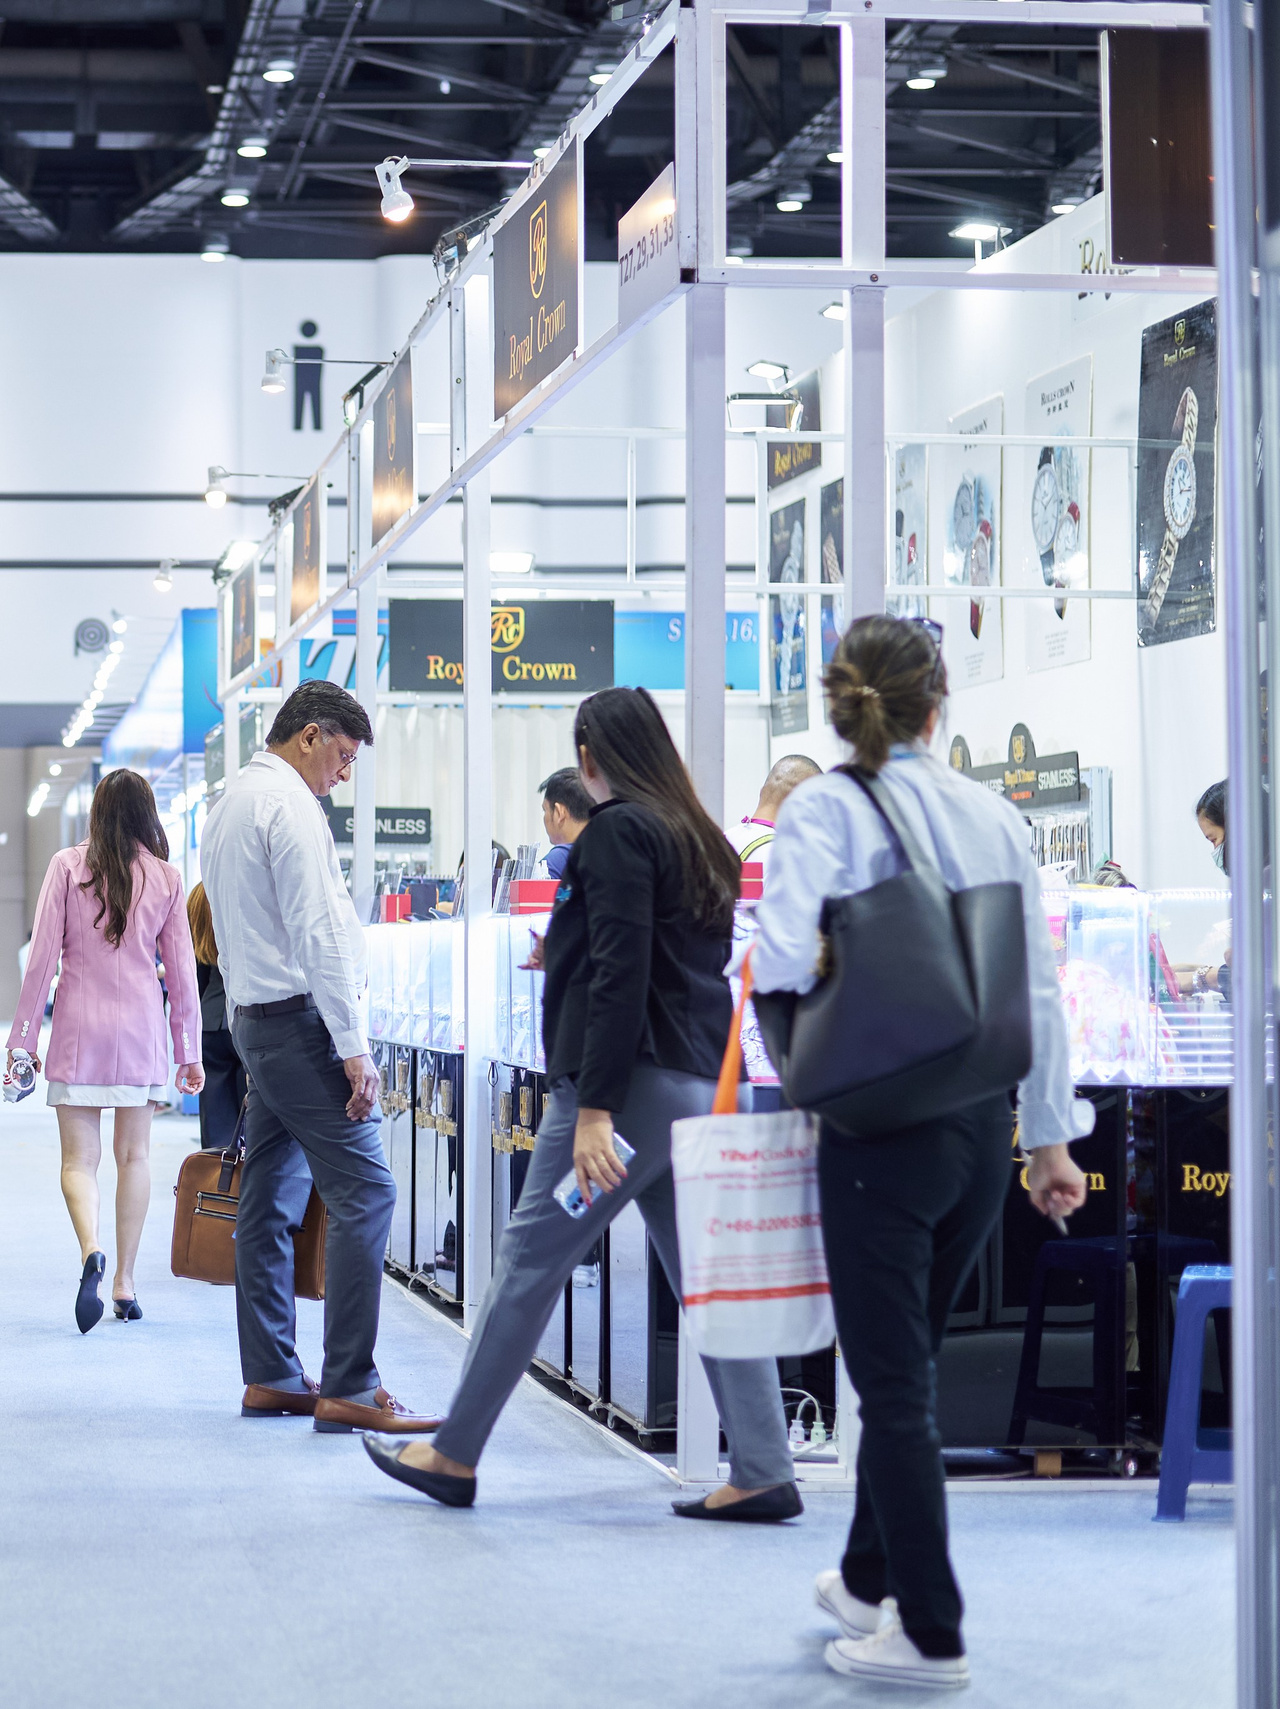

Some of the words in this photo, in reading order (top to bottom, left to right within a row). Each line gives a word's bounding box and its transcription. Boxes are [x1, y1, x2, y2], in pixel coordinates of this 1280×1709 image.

[509, 317, 534, 381] Royal
[537, 300, 567, 353] Crown
[426, 655, 464, 685] Roy
[502, 655, 577, 681] Crown
[345, 818, 426, 834] SNLESS
[1181, 1164, 1233, 1197] Roy
